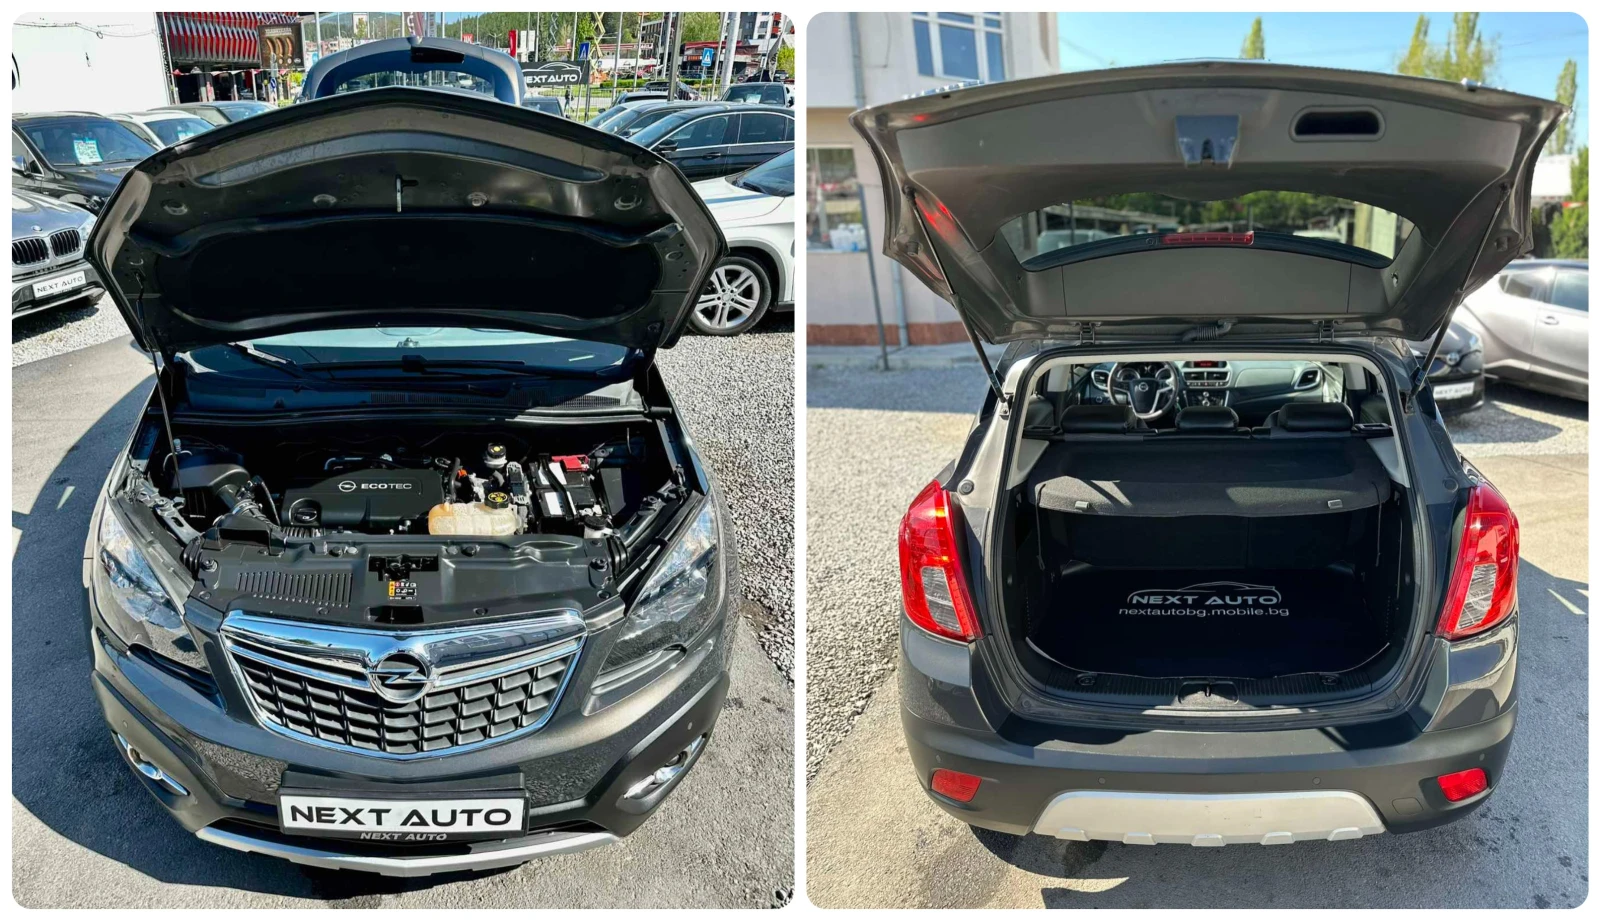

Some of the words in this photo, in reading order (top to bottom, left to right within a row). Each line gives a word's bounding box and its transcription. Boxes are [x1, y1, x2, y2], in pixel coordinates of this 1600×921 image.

[548, 74, 578, 82] AUTO
[37, 283, 58, 293] NEXT
[62, 276, 83, 286] AUTO
[1132, 595, 1198, 604] NEXT
[1204, 595, 1278, 605] AUTO
[1119, 607, 1289, 617] nextautobg.mobile.bg
[291, 805, 391, 825] NEXT
[400, 808, 512, 826] AUTO
[360, 833, 402, 841] NEXT
[405, 833, 447, 841] AUTO
